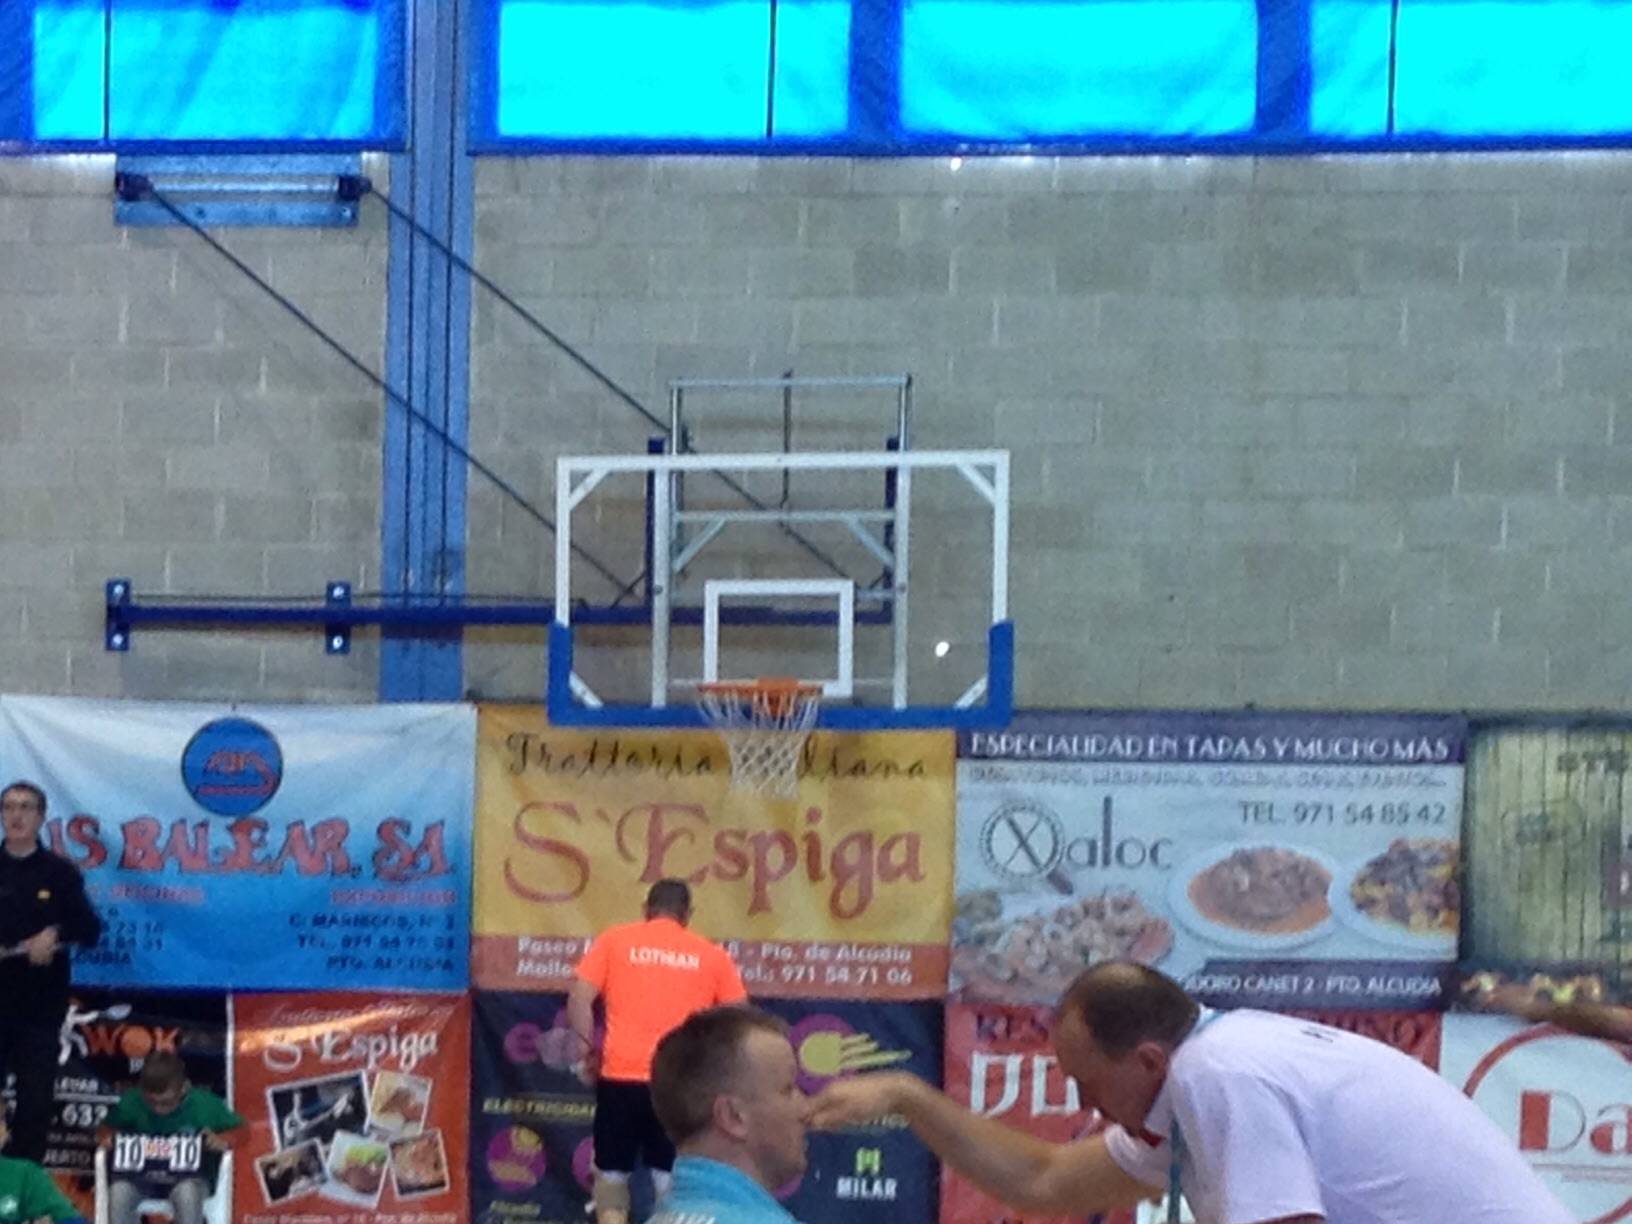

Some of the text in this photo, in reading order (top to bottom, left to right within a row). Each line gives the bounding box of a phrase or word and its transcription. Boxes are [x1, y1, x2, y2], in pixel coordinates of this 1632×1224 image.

[971, 732, 1143, 758] ESPECIALIDAD
[1148, 735, 1179, 759] EN
[1186, 736, 1266, 760] TAPAS
[1272, 737, 1291, 759] Y
[1294, 737, 1389, 760] MUCHO
[1294, 802, 1335, 826] 971
[1417, 803, 1446, 826] 42
[836, 1176, 898, 1200] MILAR
